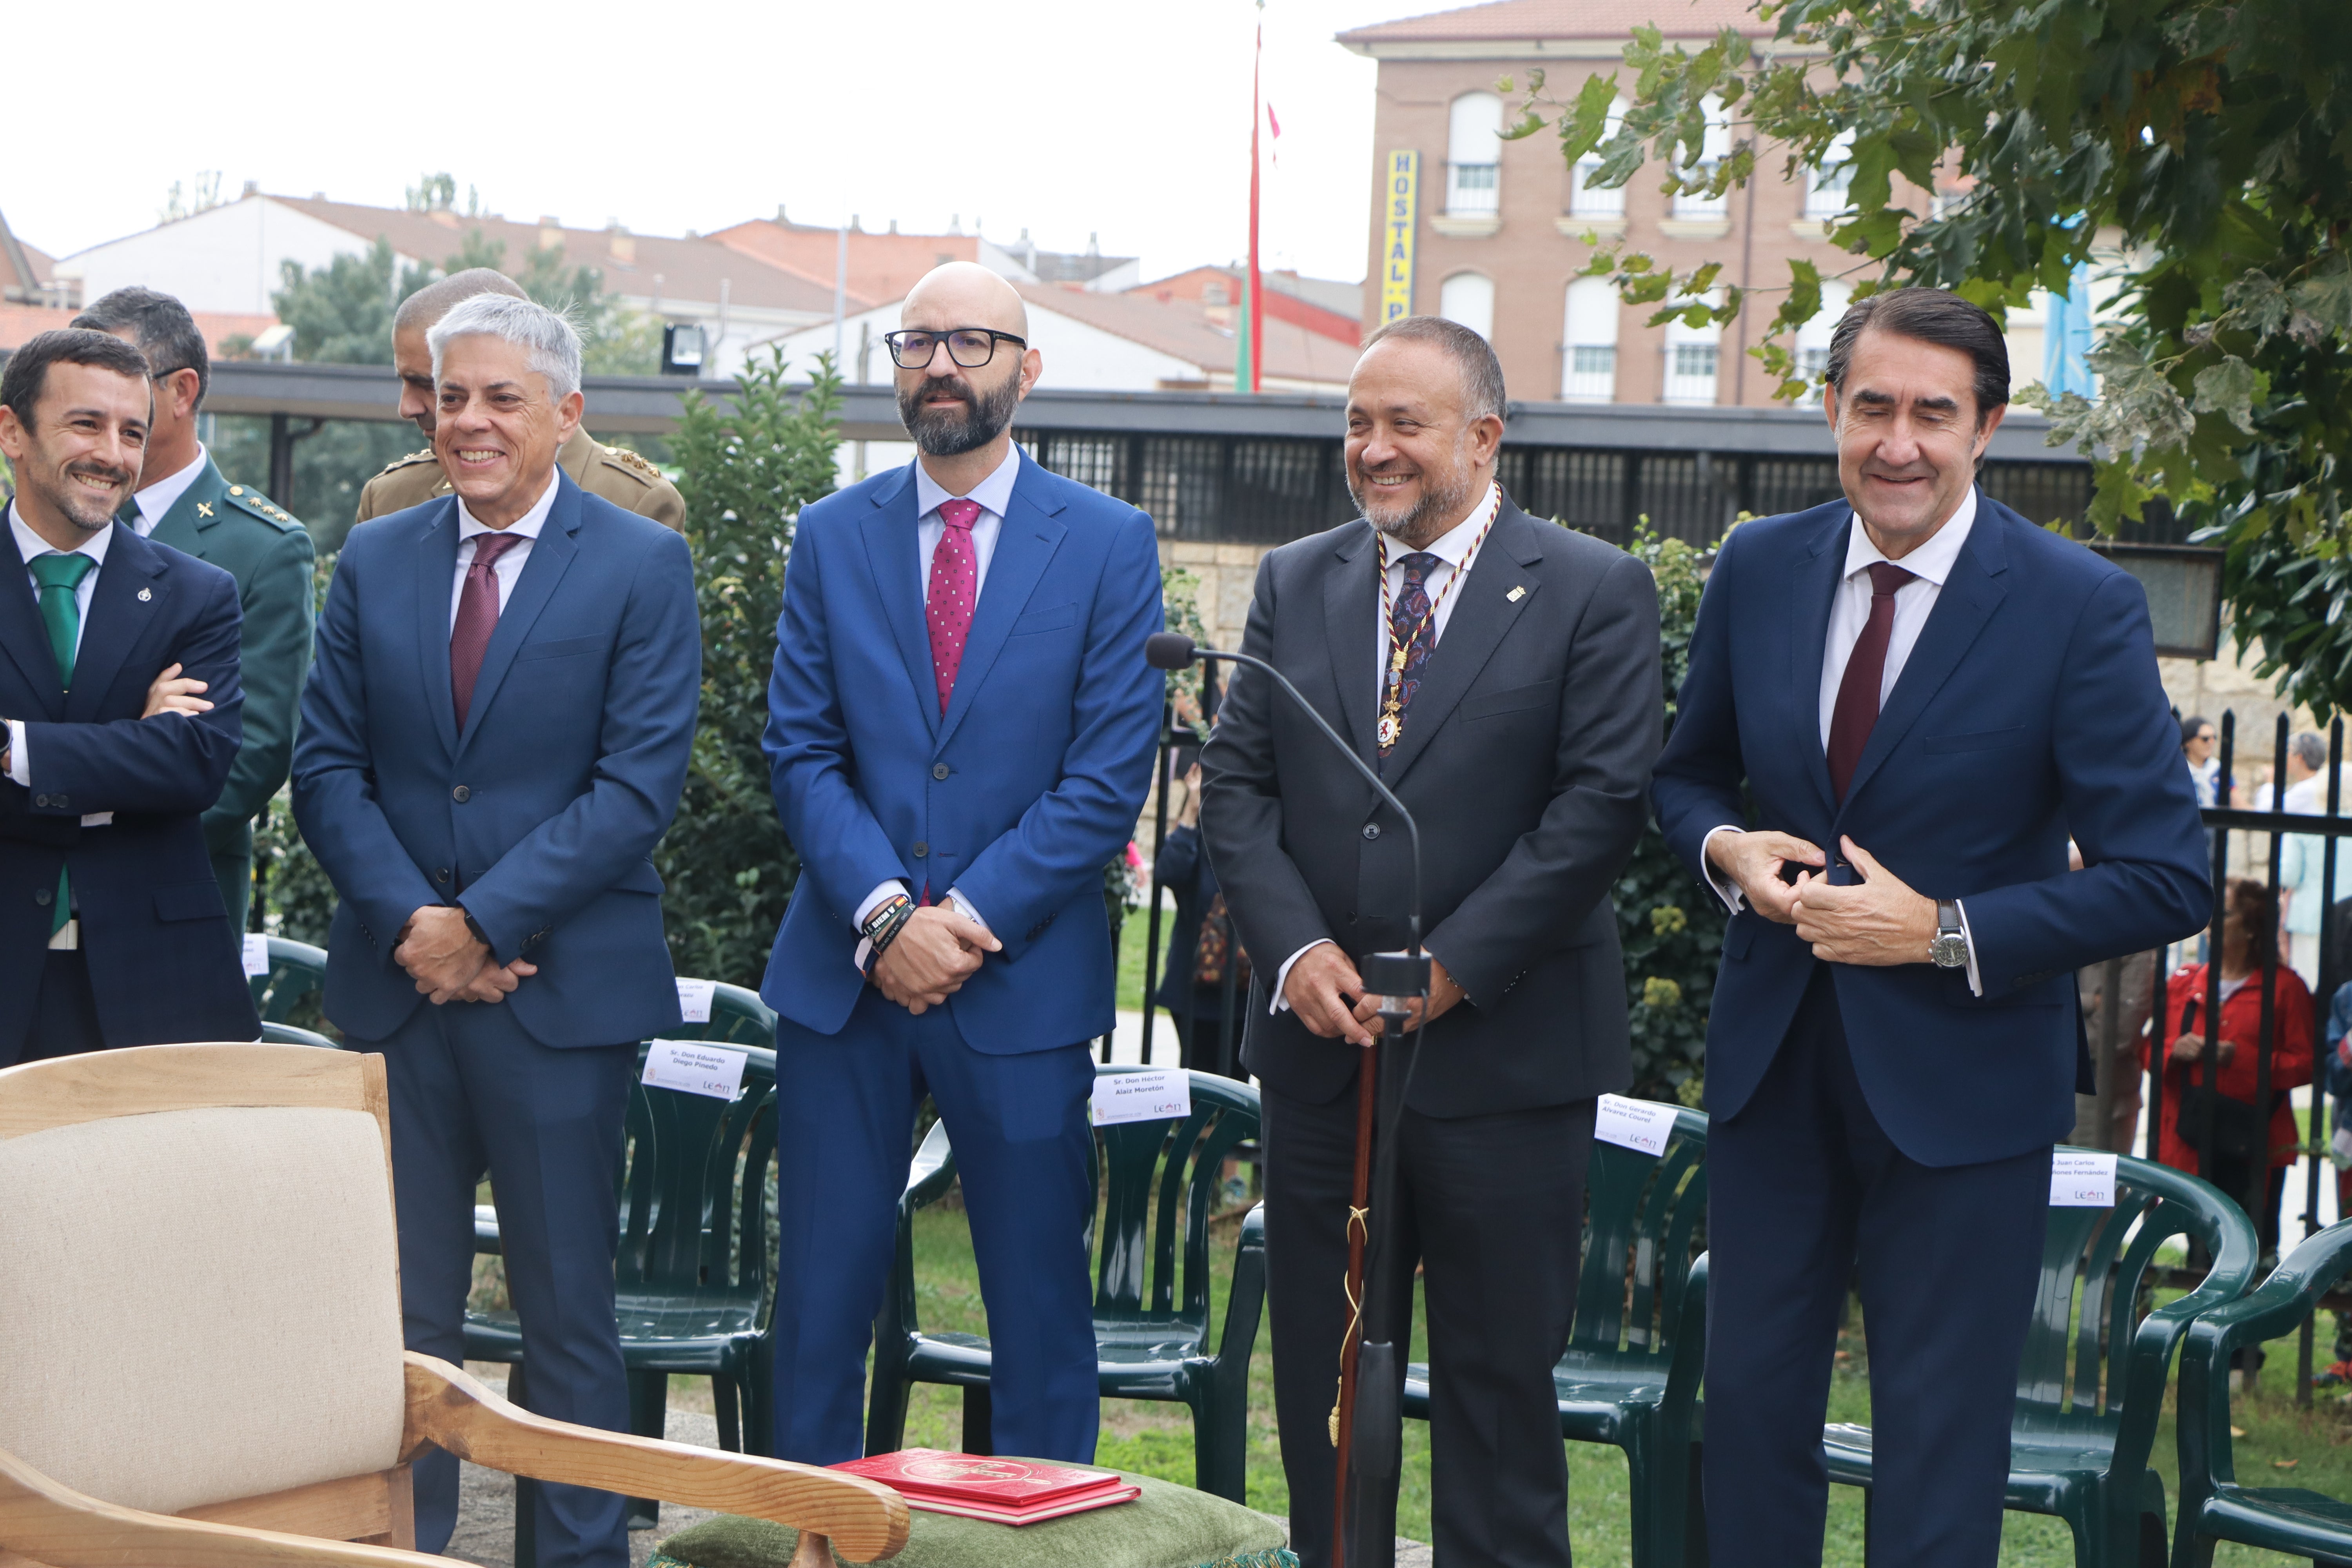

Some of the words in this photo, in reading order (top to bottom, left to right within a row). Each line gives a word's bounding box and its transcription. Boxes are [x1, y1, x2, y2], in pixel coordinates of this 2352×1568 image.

[1392, 154, 1409, 281] HOSTAL
[697, 1054, 725, 1063] Eduardo
[695, 1061, 718, 1070] Pinedo
[1135, 1084, 1164, 1093] Moretón
[1629, 1106, 1656, 1116] Gerardo
[1629, 1113, 1651, 1123] Courel
